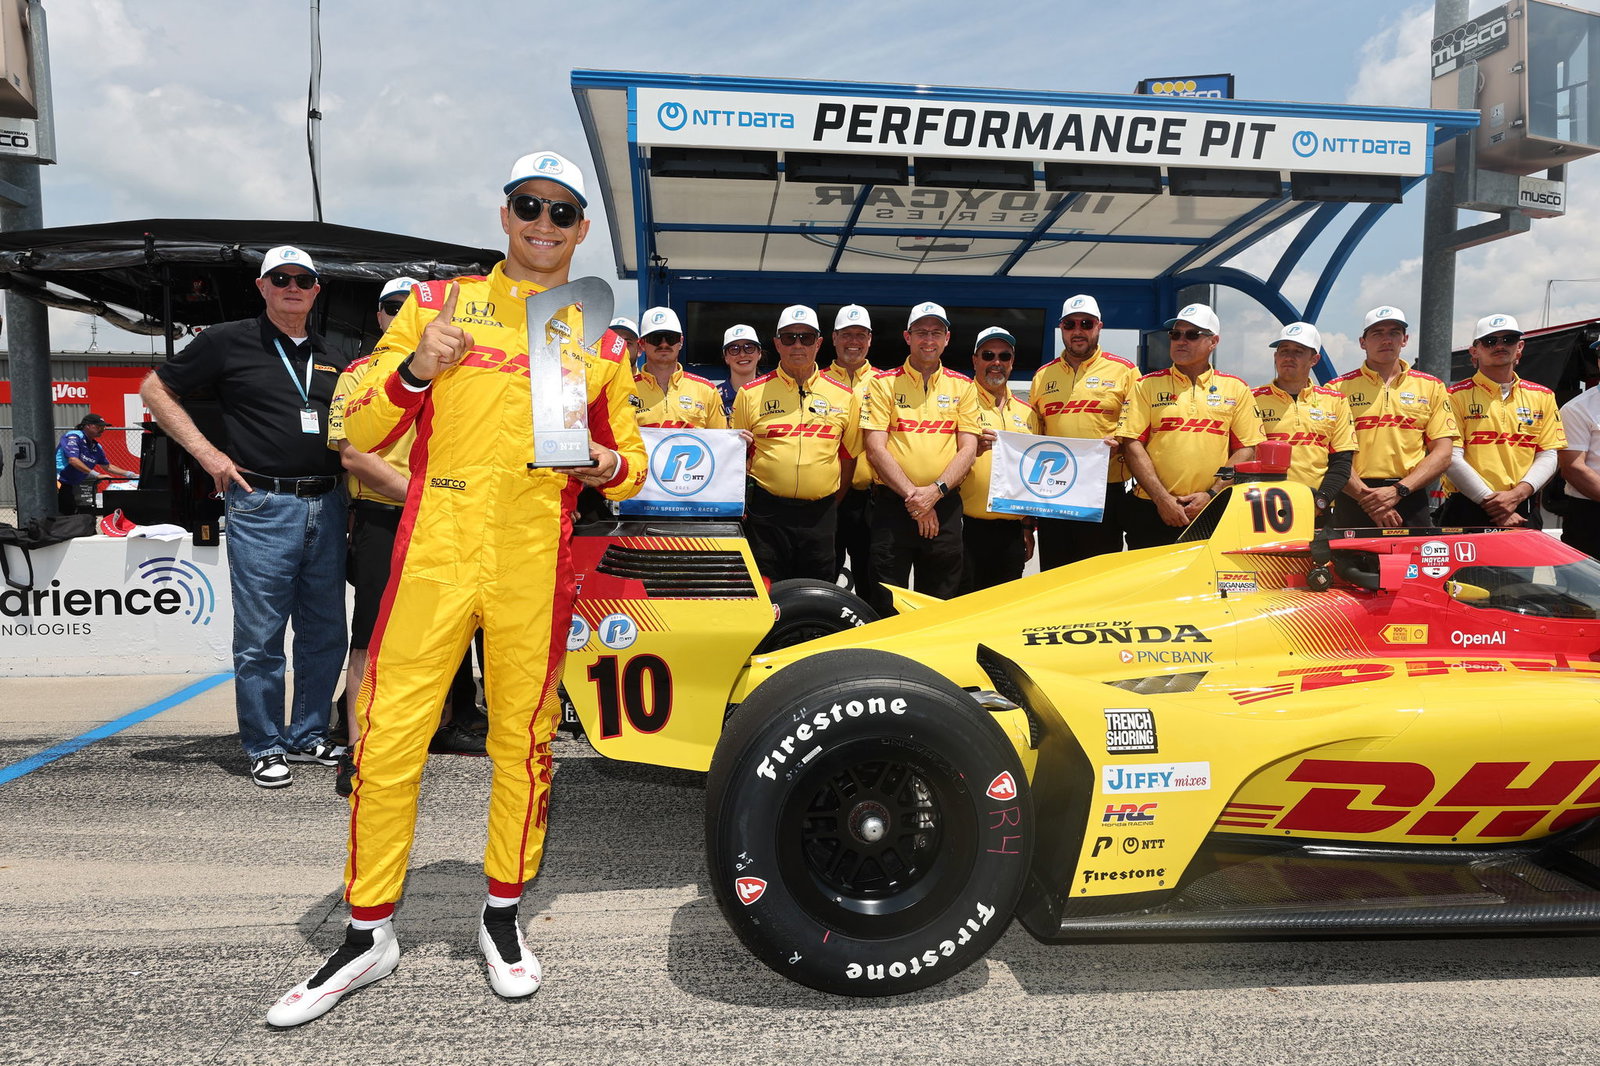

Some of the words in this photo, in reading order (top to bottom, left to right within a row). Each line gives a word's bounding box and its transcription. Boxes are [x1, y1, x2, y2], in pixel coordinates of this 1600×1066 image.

[692, 109, 736, 127] NTT
[812, 102, 1187, 156] PERFORMANCE
[1200, 119, 1277, 160] PIT
[1322, 137, 1360, 153] NTT
[451, 316, 505, 329] HONDA
[457, 344, 532, 378] DH
[1044, 400, 1104, 417] DHL
[766, 423, 836, 439] DHL
[896, 418, 957, 434] DHL
[1157, 417, 1226, 436] DHL
[1355, 414, 1418, 431] DHL
[559, 441, 582, 451] NTT
[1469, 431, 1538, 448] DHL
[430, 474, 467, 490] sparco
[1025, 506, 1054, 514] SPEEDWAY
[1243, 487, 1295, 534] 10
[1, 623, 92, 636] NOLOGIES
[1022, 621, 1108, 633] POWERED
[1112, 620, 1132, 628] by
[1022, 624, 1213, 646] HONDA
[1451, 630, 1506, 648] OpenAI
[587, 653, 673, 741] 10
[1105, 713, 1153, 731] TRENCH
[756, 696, 908, 782] Firestone
[1106, 730, 1154, 746] SHORING
[1175, 774, 1207, 787] mixes
[1102, 802, 1158, 822] HRC
[1141, 838, 1165, 850] NTT
[1083, 868, 1165, 884] Firestone
[845, 901, 996, 980] Firestone
